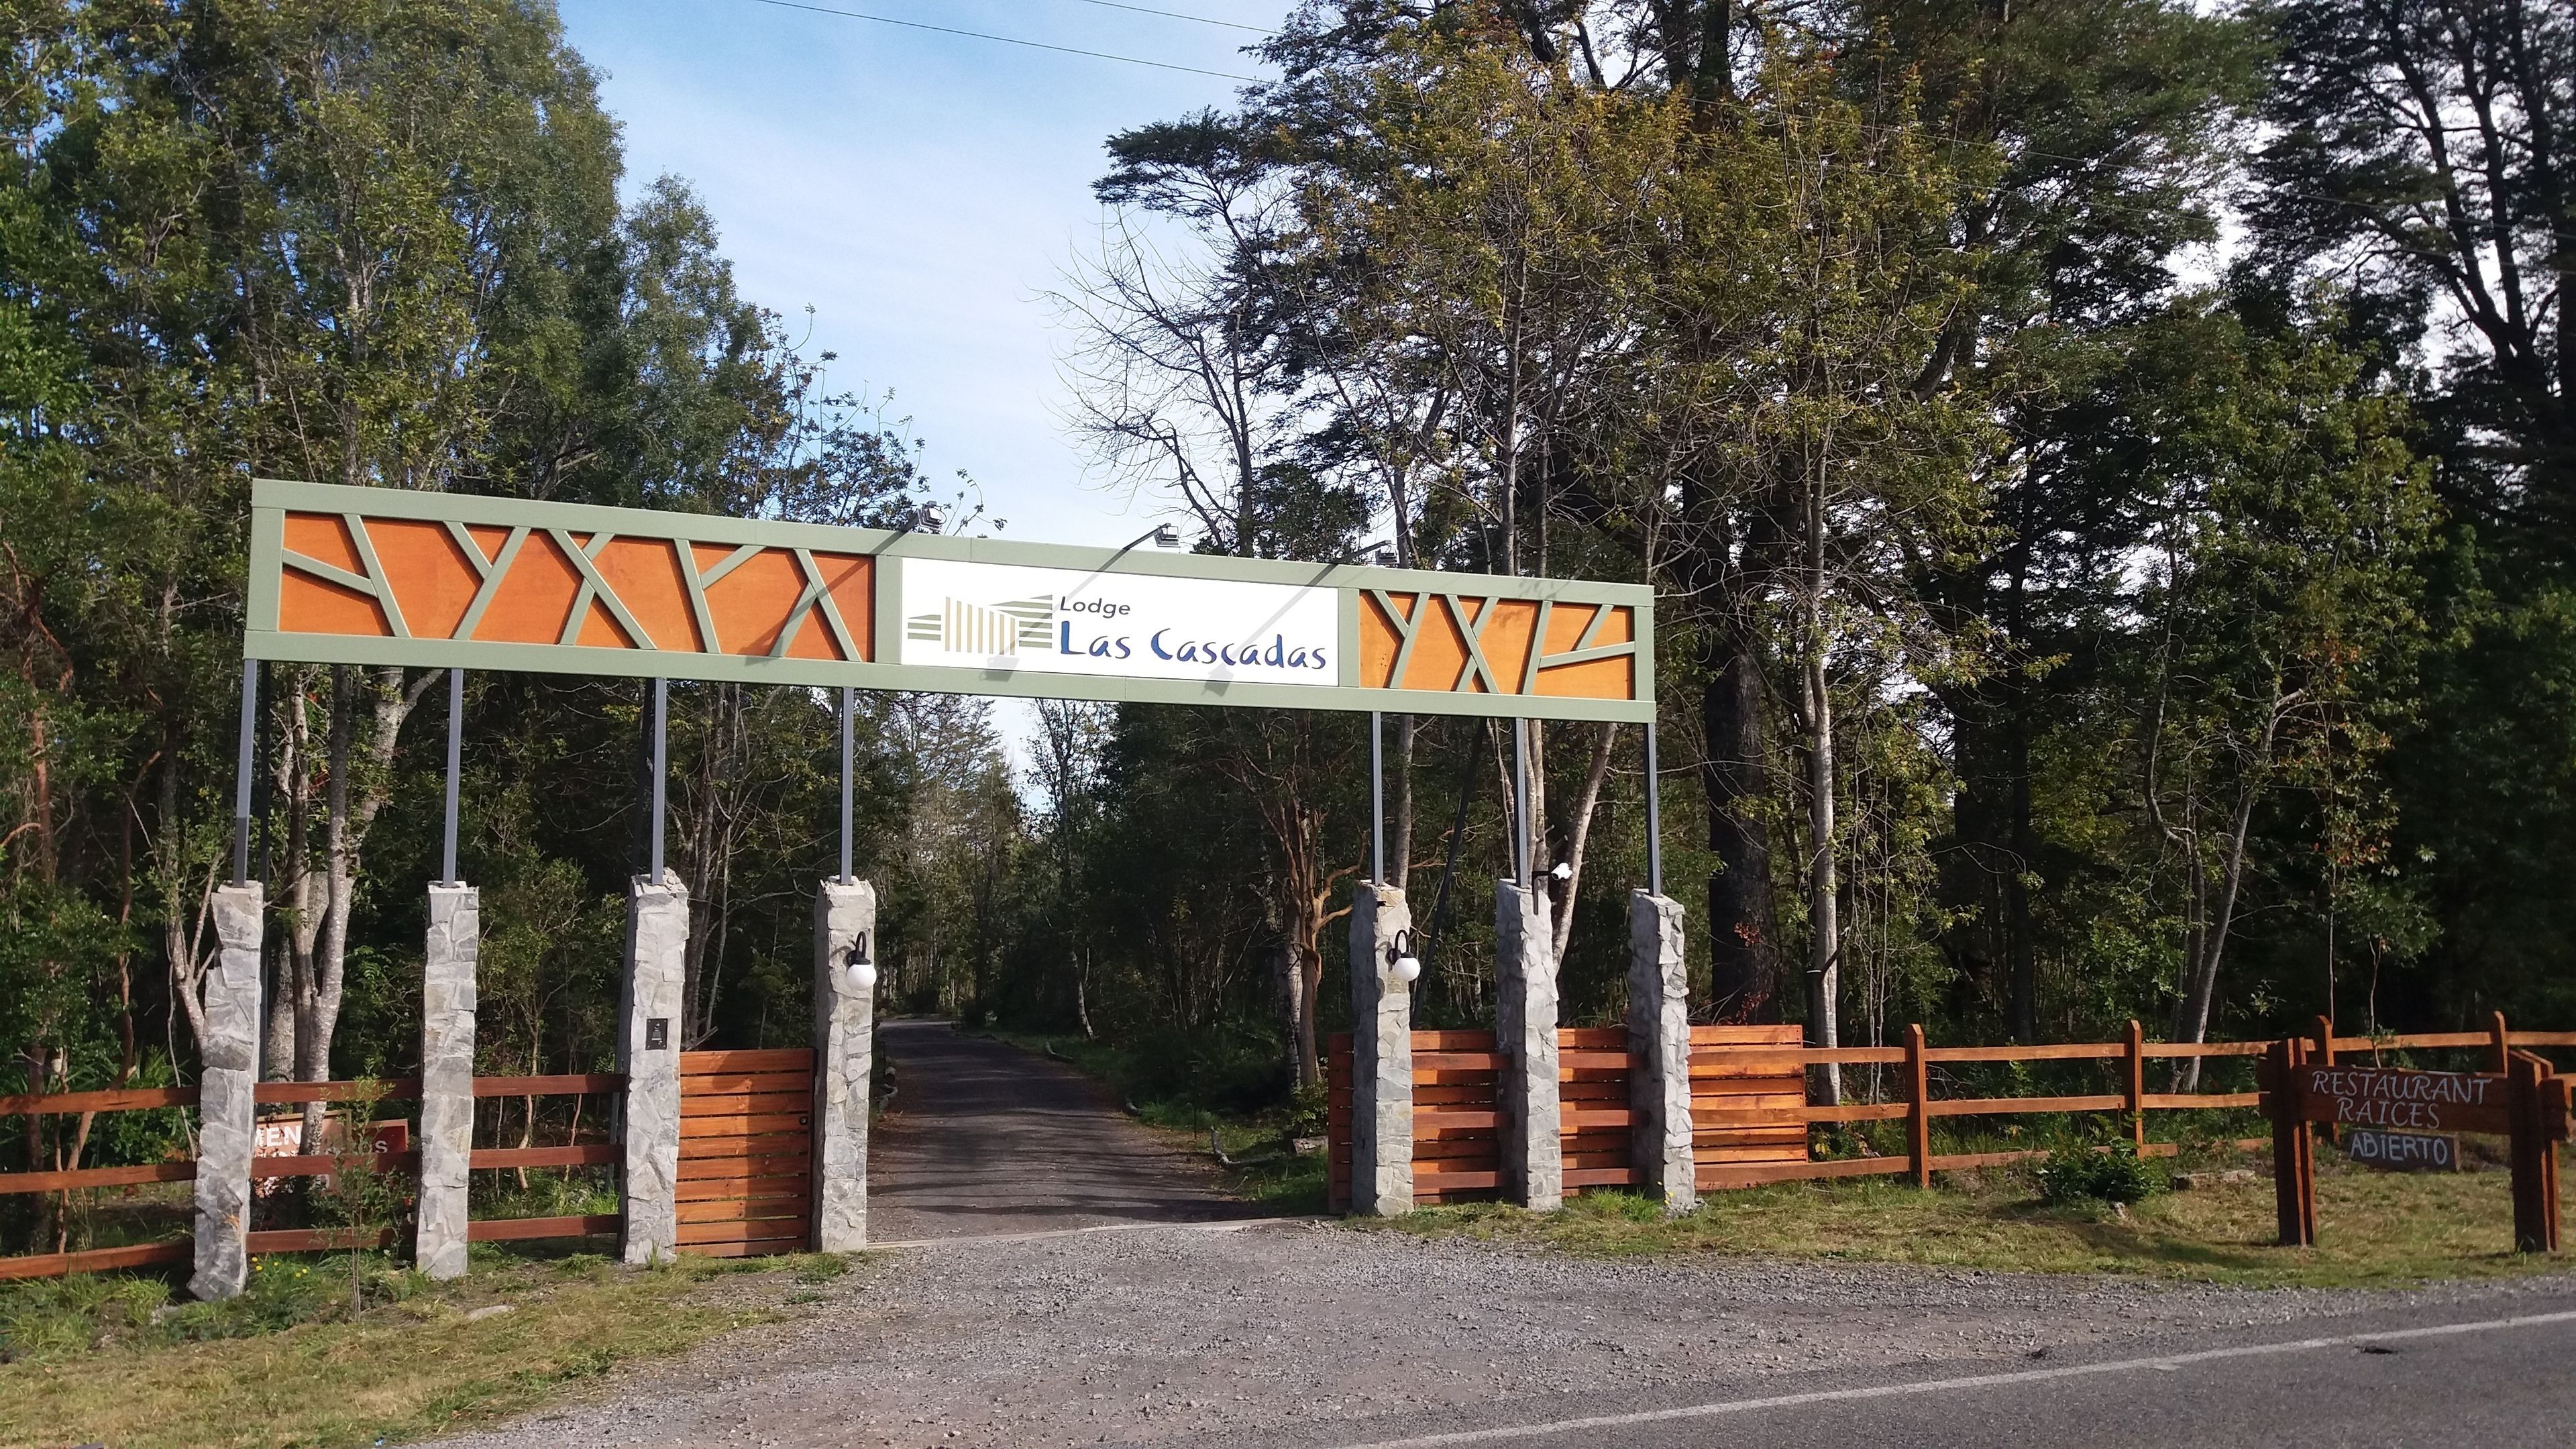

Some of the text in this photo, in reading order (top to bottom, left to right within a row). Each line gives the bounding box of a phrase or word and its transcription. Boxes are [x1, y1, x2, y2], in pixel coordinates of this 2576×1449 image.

[1060, 596, 1130, 619] Lodge
[1061, 621, 1326, 669] Las Cascadas
[2313, 1071, 2492, 1105] RESTAURANT
